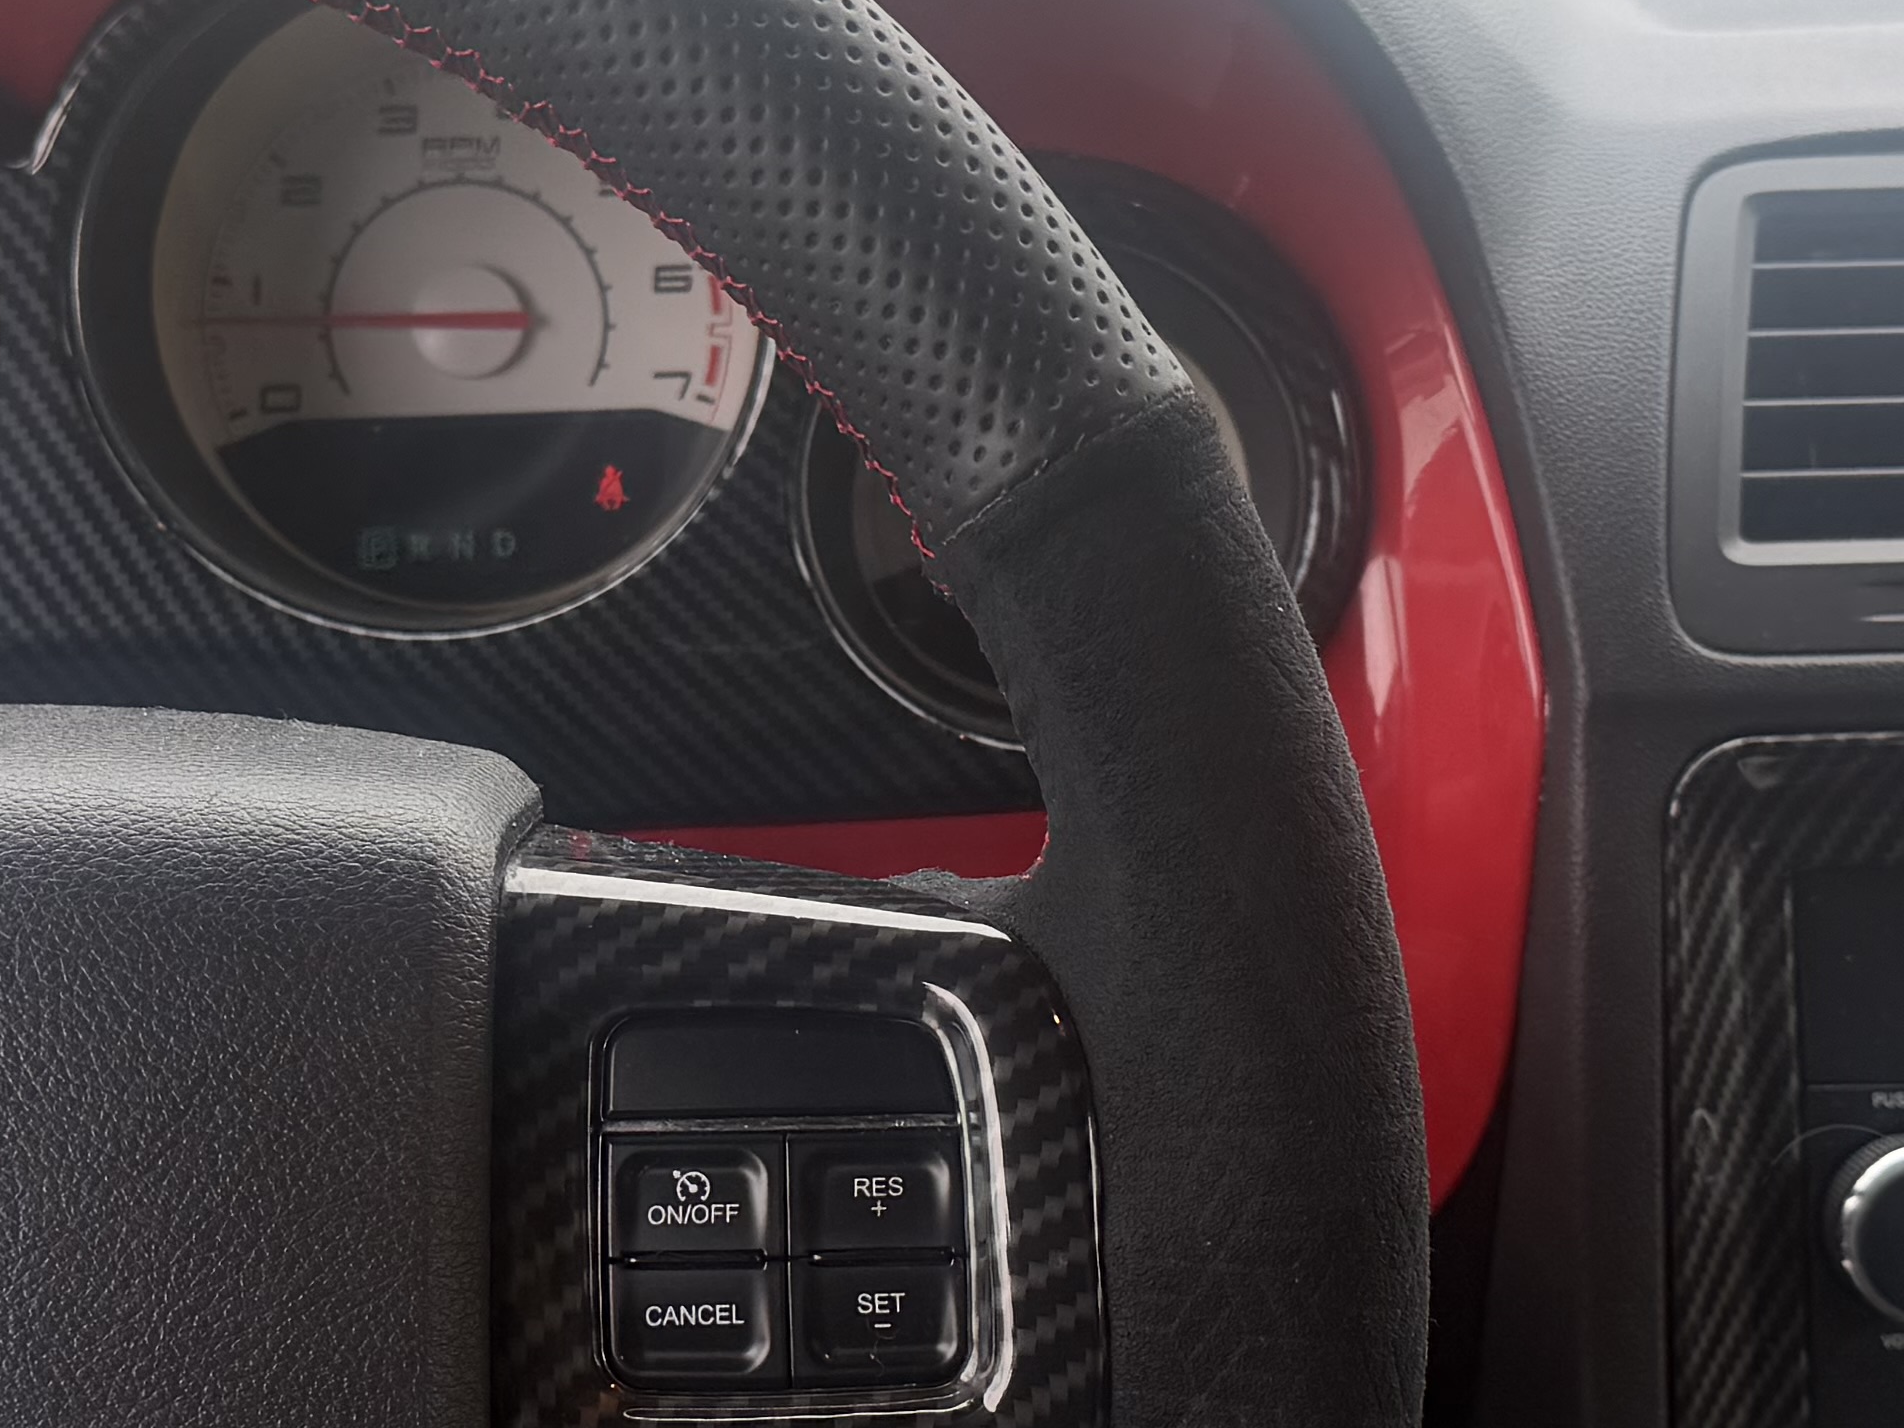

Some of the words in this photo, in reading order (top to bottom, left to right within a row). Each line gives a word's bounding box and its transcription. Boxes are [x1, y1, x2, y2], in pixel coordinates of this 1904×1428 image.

[653, 264, 694, 294] 6
[653, 371, 693, 400] 7
[853, 1176, 904, 1198] RES
[647, 1203, 740, 1227] ON/OFF
[645, 1303, 745, 1328] CANCEL
[856, 1292, 906, 1315] SET
